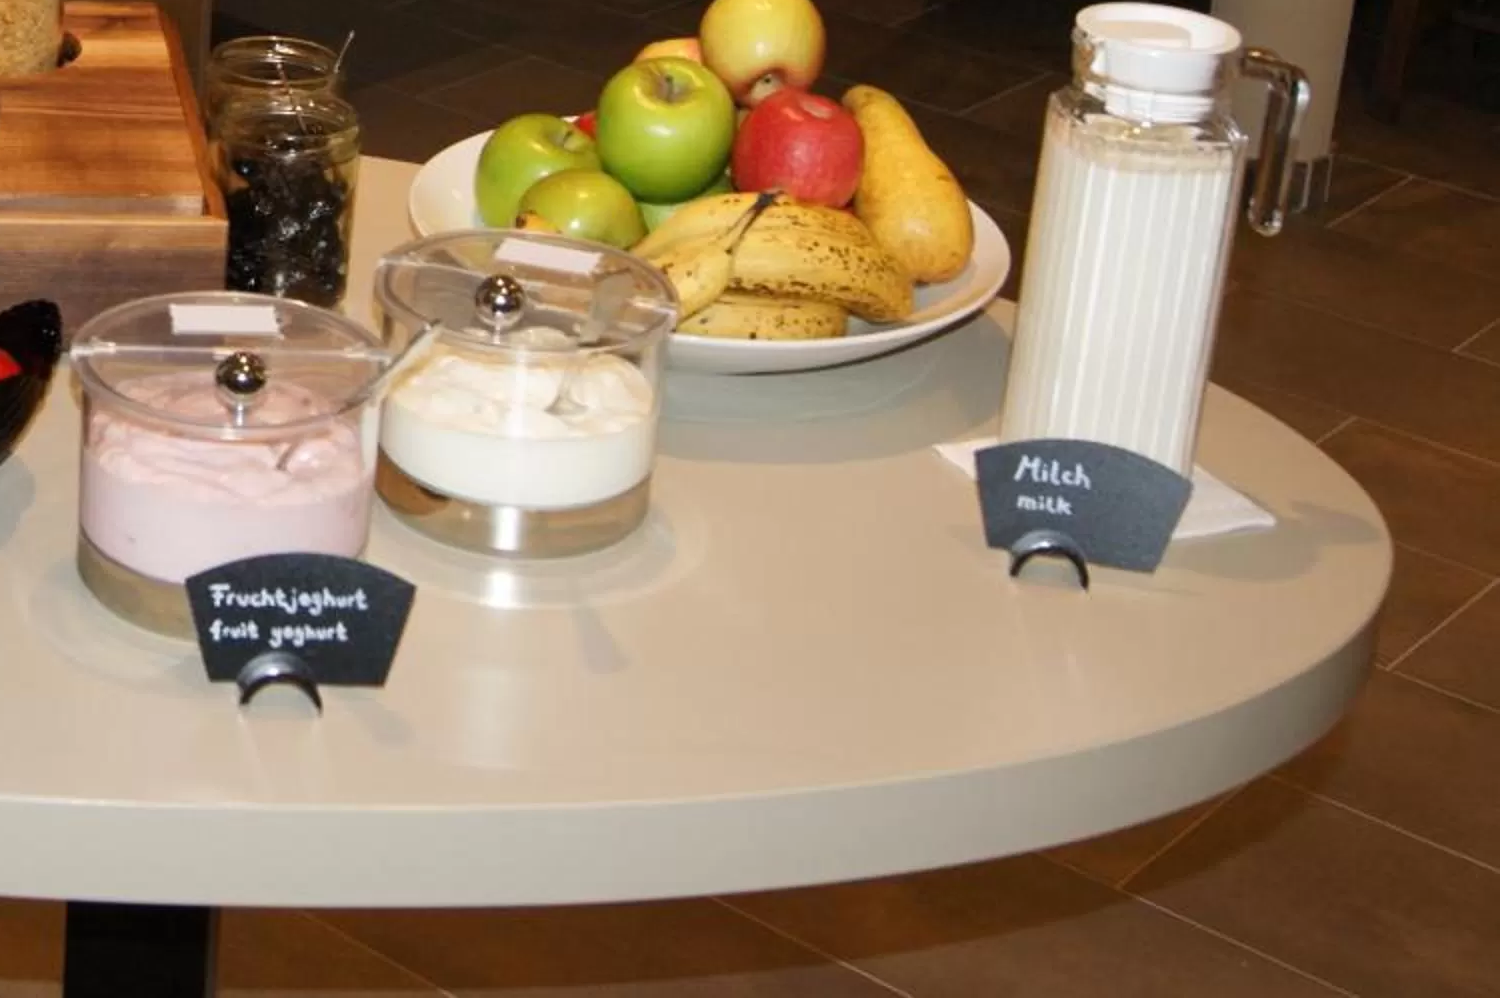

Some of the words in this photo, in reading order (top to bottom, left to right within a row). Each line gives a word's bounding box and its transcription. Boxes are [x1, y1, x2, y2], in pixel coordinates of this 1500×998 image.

[1013, 454, 1091, 490] Milch
[1016, 494, 1073, 515] milk
[208, 582, 369, 616] Fruchtjoghurt
[208, 617, 260, 642] fruit
[268, 621, 349, 648] yoghurt
